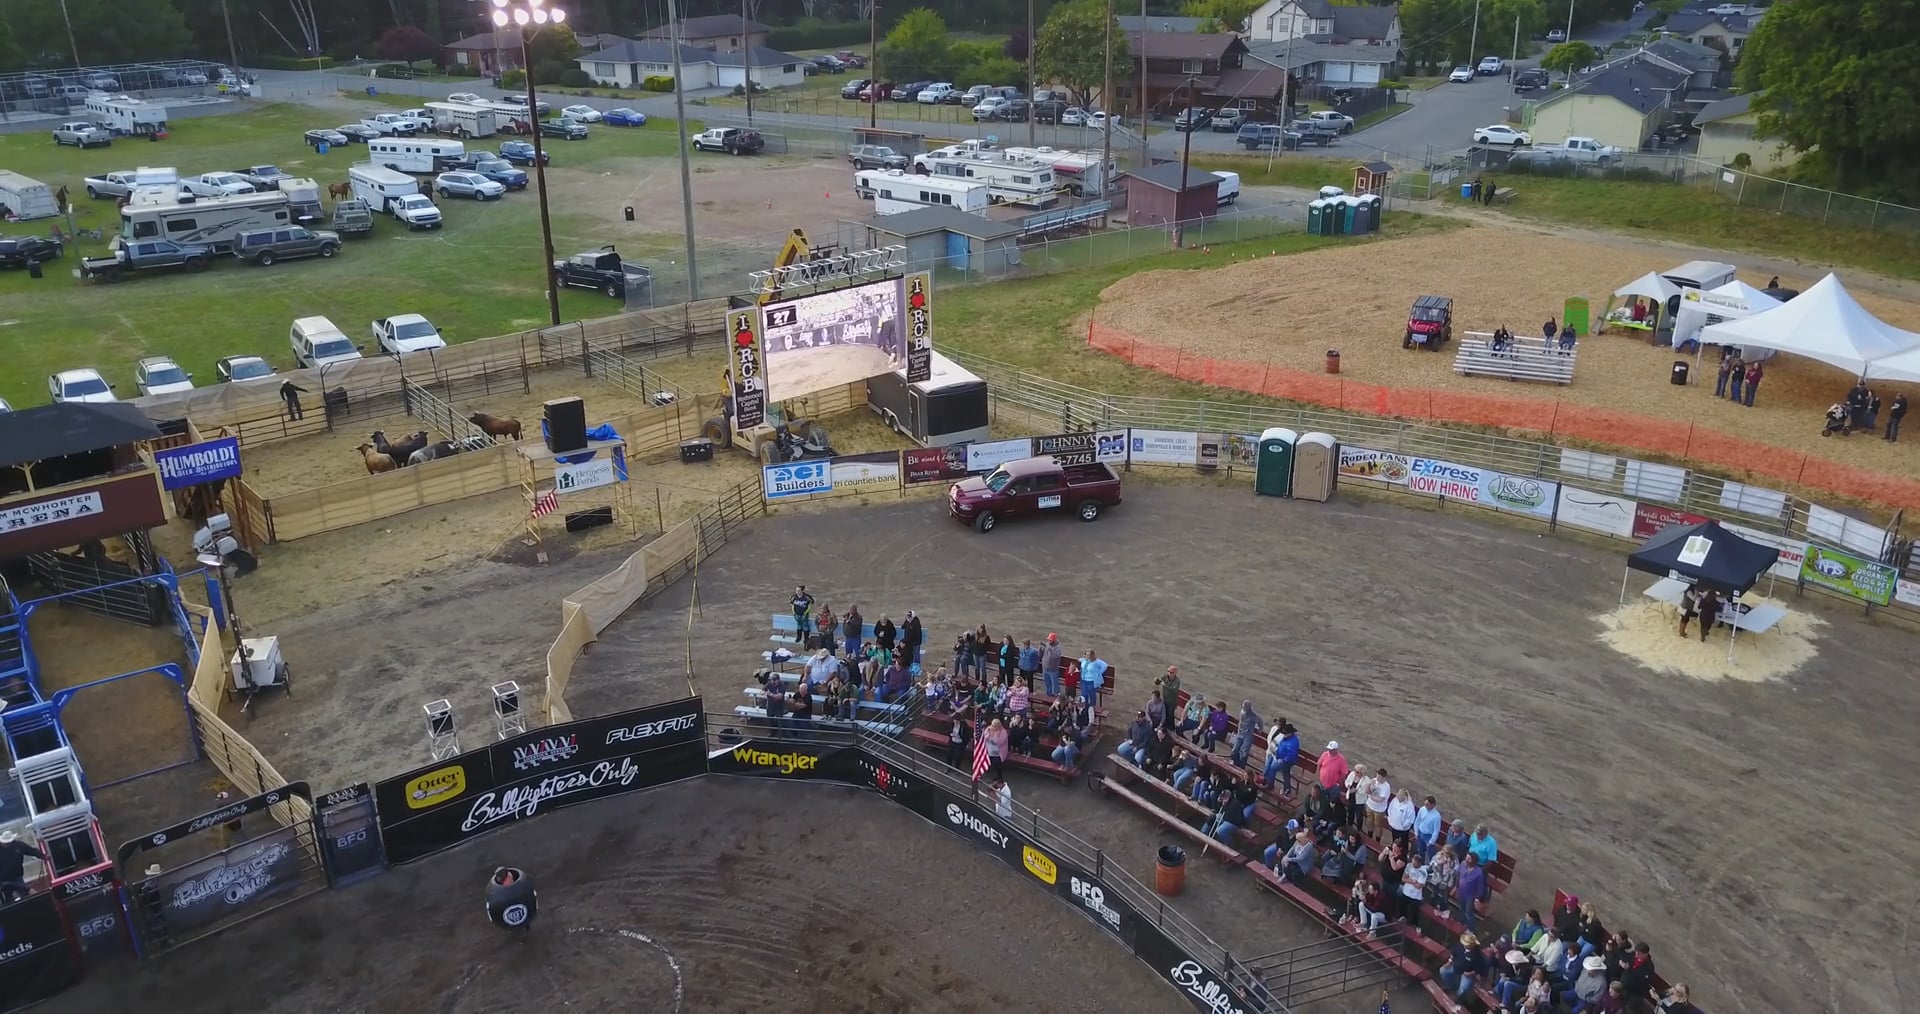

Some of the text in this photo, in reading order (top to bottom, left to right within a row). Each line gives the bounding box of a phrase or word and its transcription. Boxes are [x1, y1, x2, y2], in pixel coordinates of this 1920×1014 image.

[773, 310, 790, 325] 27
[1037, 433, 1097, 454] JOHNNY'S
[158, 445, 235, 479] HUMBOLDT
[1340, 452, 1408, 469] RODEO FANS
[575, 465, 611, 479] Hennessy
[575, 474, 600, 487] Funds
[844, 477, 877, 487] counties
[877, 473, 897, 483] bank
[775, 479, 825, 492] Builders
[1410, 476, 1437, 492] NOW
[1440, 480, 1479, 501] HIRING
[1496, 474, 1540, 500] J&G
[13, 495, 92, 517] MCWHORTER
[0, 503, 93, 531] RENA
[1637, 509, 1658, 519] Heidi
[1659, 513, 1681, 526] Olsen
[1856, 568, 1889, 582] ORGANIC
[1852, 580, 1886, 596] SUPPLIES
[1876, 580, 1890, 590] PET
[605, 713, 697, 745] FLEXFIT
[732, 747, 818, 775] Wrangler
[417, 773, 456, 791] Otter
[461, 756, 640, 832] Bullfighters Only
[336, 830, 367, 848] BFO
[963, 811, 1009, 849] HOOEY
[1070, 876, 1104, 904] BFO
[79, 916, 115, 937] BFO
